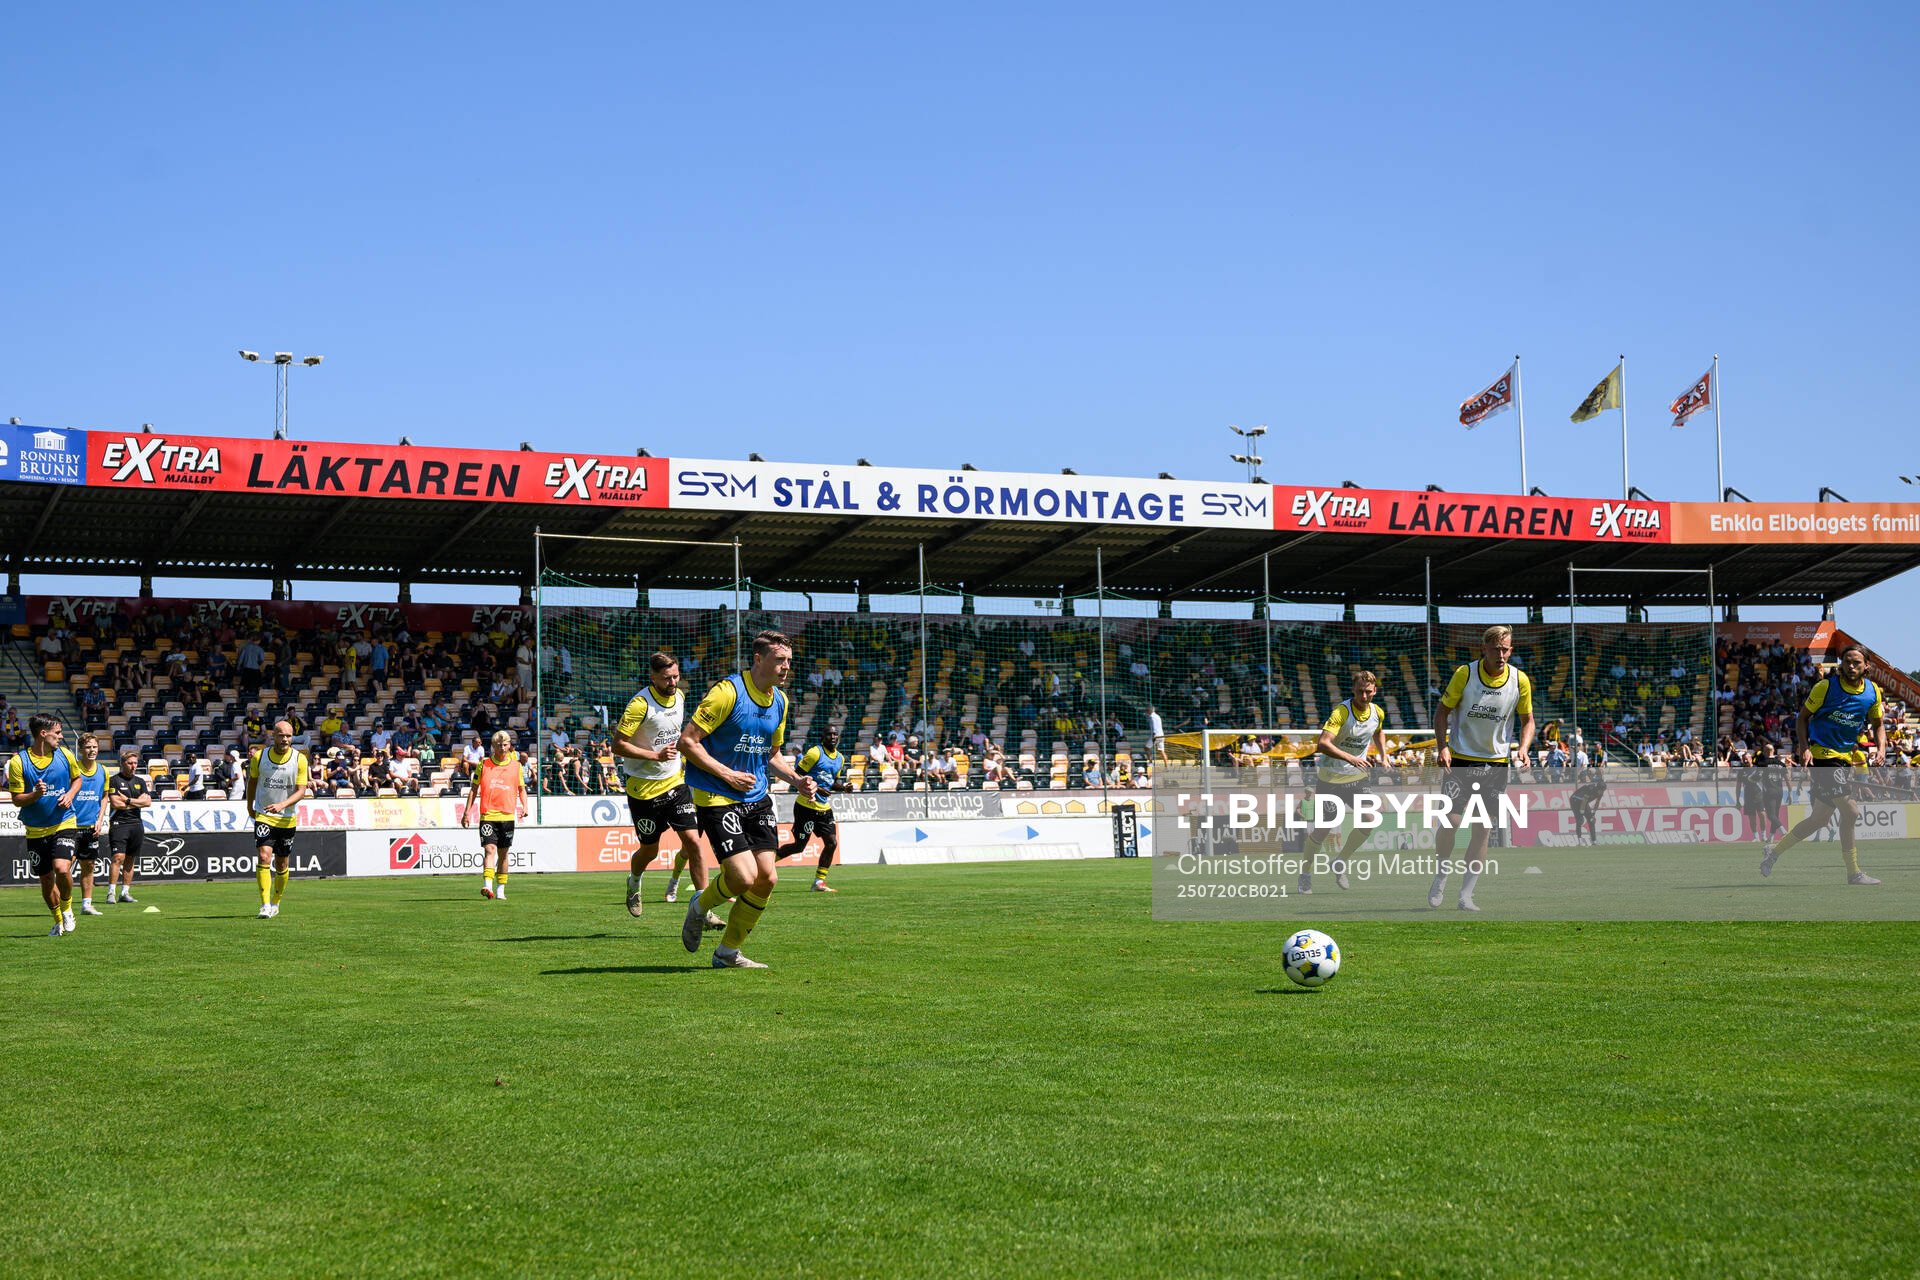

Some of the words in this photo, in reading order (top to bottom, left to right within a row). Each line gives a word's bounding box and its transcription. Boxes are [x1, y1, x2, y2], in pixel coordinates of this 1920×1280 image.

[20, 451, 80, 464] RONNEBY
[102, 437, 221, 483] EXTRA
[20, 461, 79, 477] BRUNN
[164, 473, 216, 485] MJÄLLBY
[246, 445, 521, 497] LÄKTAREN
[544, 457, 648, 501] EXTRA
[678, 471, 757, 498] SRM
[773, 470, 859, 510] STÅL
[877, 481, 901, 511] &
[918, 476, 1183, 522] RÖRMONTAGE
[1201, 492, 1267, 518] SRM
[1291, 490, 1372, 527] EXTRA
[1388, 495, 1574, 535] LÄKTAREN
[1590, 502, 1661, 538] EXTRA
[1710, 514, 1763, 532] Enkla
[1769, 514, 1868, 535] Elbolagets
[1472, 704, 1497, 713] Enkla
[740, 734, 765, 744] Enkla
[904, 792, 984, 812] marching
[1121, 811, 1136, 857] SELECT
[1645, 829, 1697, 844] UNIBET
[721, 840, 734, 852] 17
[421, 852, 536, 869] HÖJDBOGET
[1292, 949, 1321, 961] SELECT
